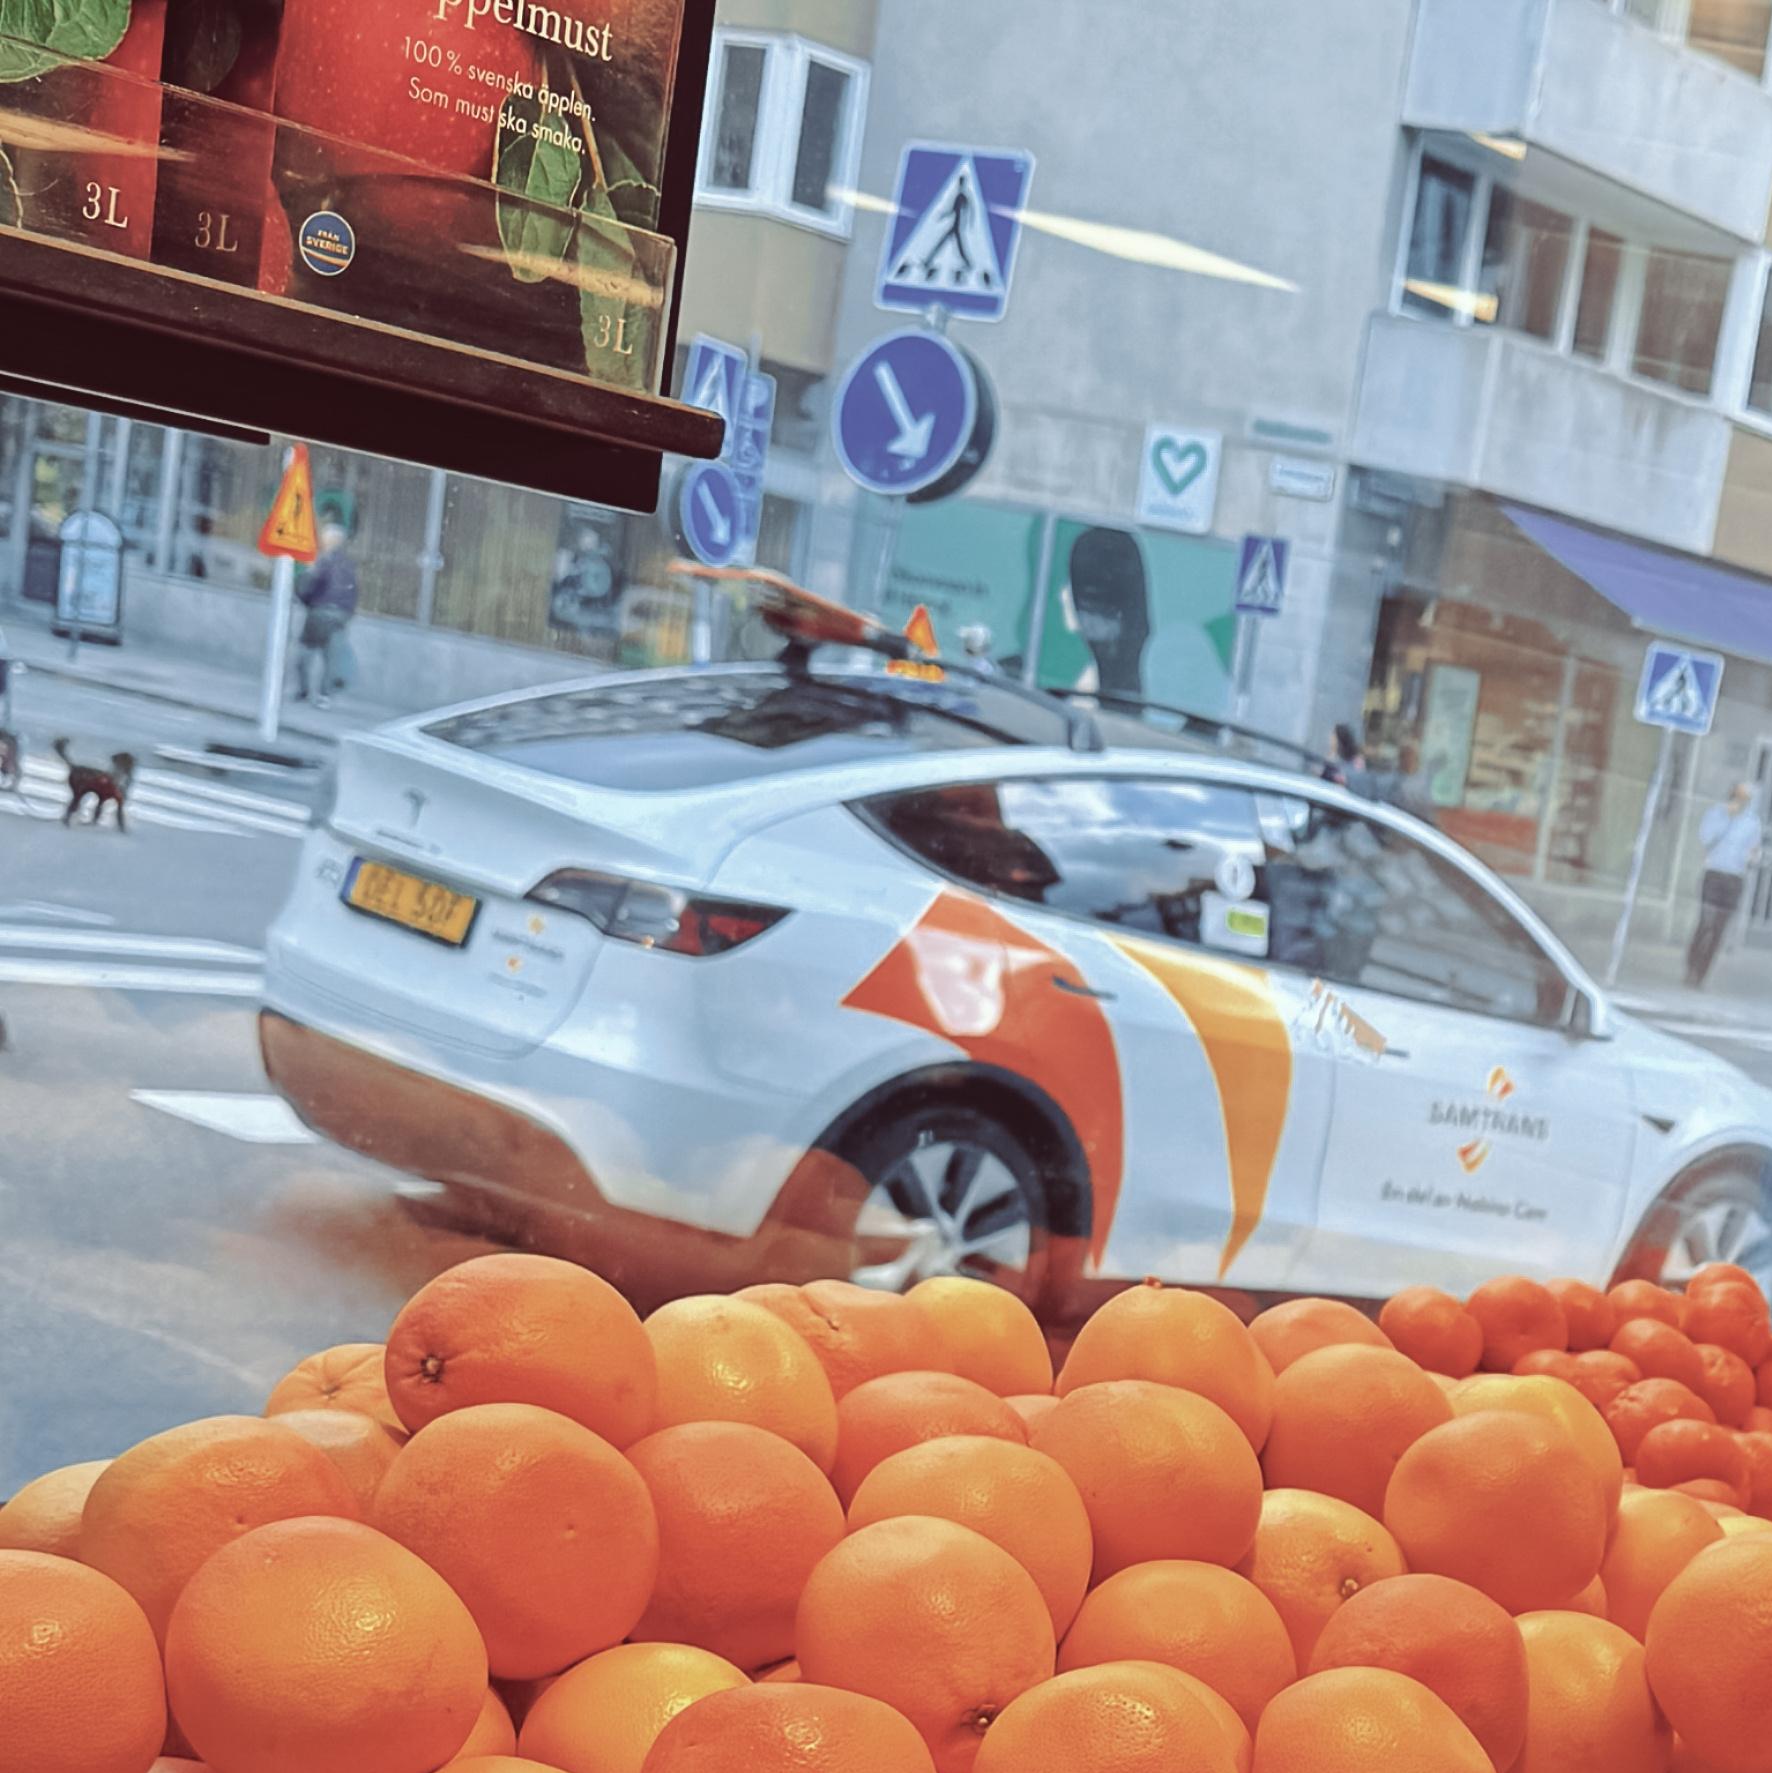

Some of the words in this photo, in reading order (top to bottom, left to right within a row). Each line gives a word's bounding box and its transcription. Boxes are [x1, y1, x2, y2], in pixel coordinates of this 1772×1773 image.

[408, 77, 449, 109] Som
[456, 98, 495, 124] must
[499, 106, 528, 134] ska
[531, 124, 586, 154] smaka.
[468, 65, 533, 100] svenska
[538, 83, 596, 122] äpplen.
